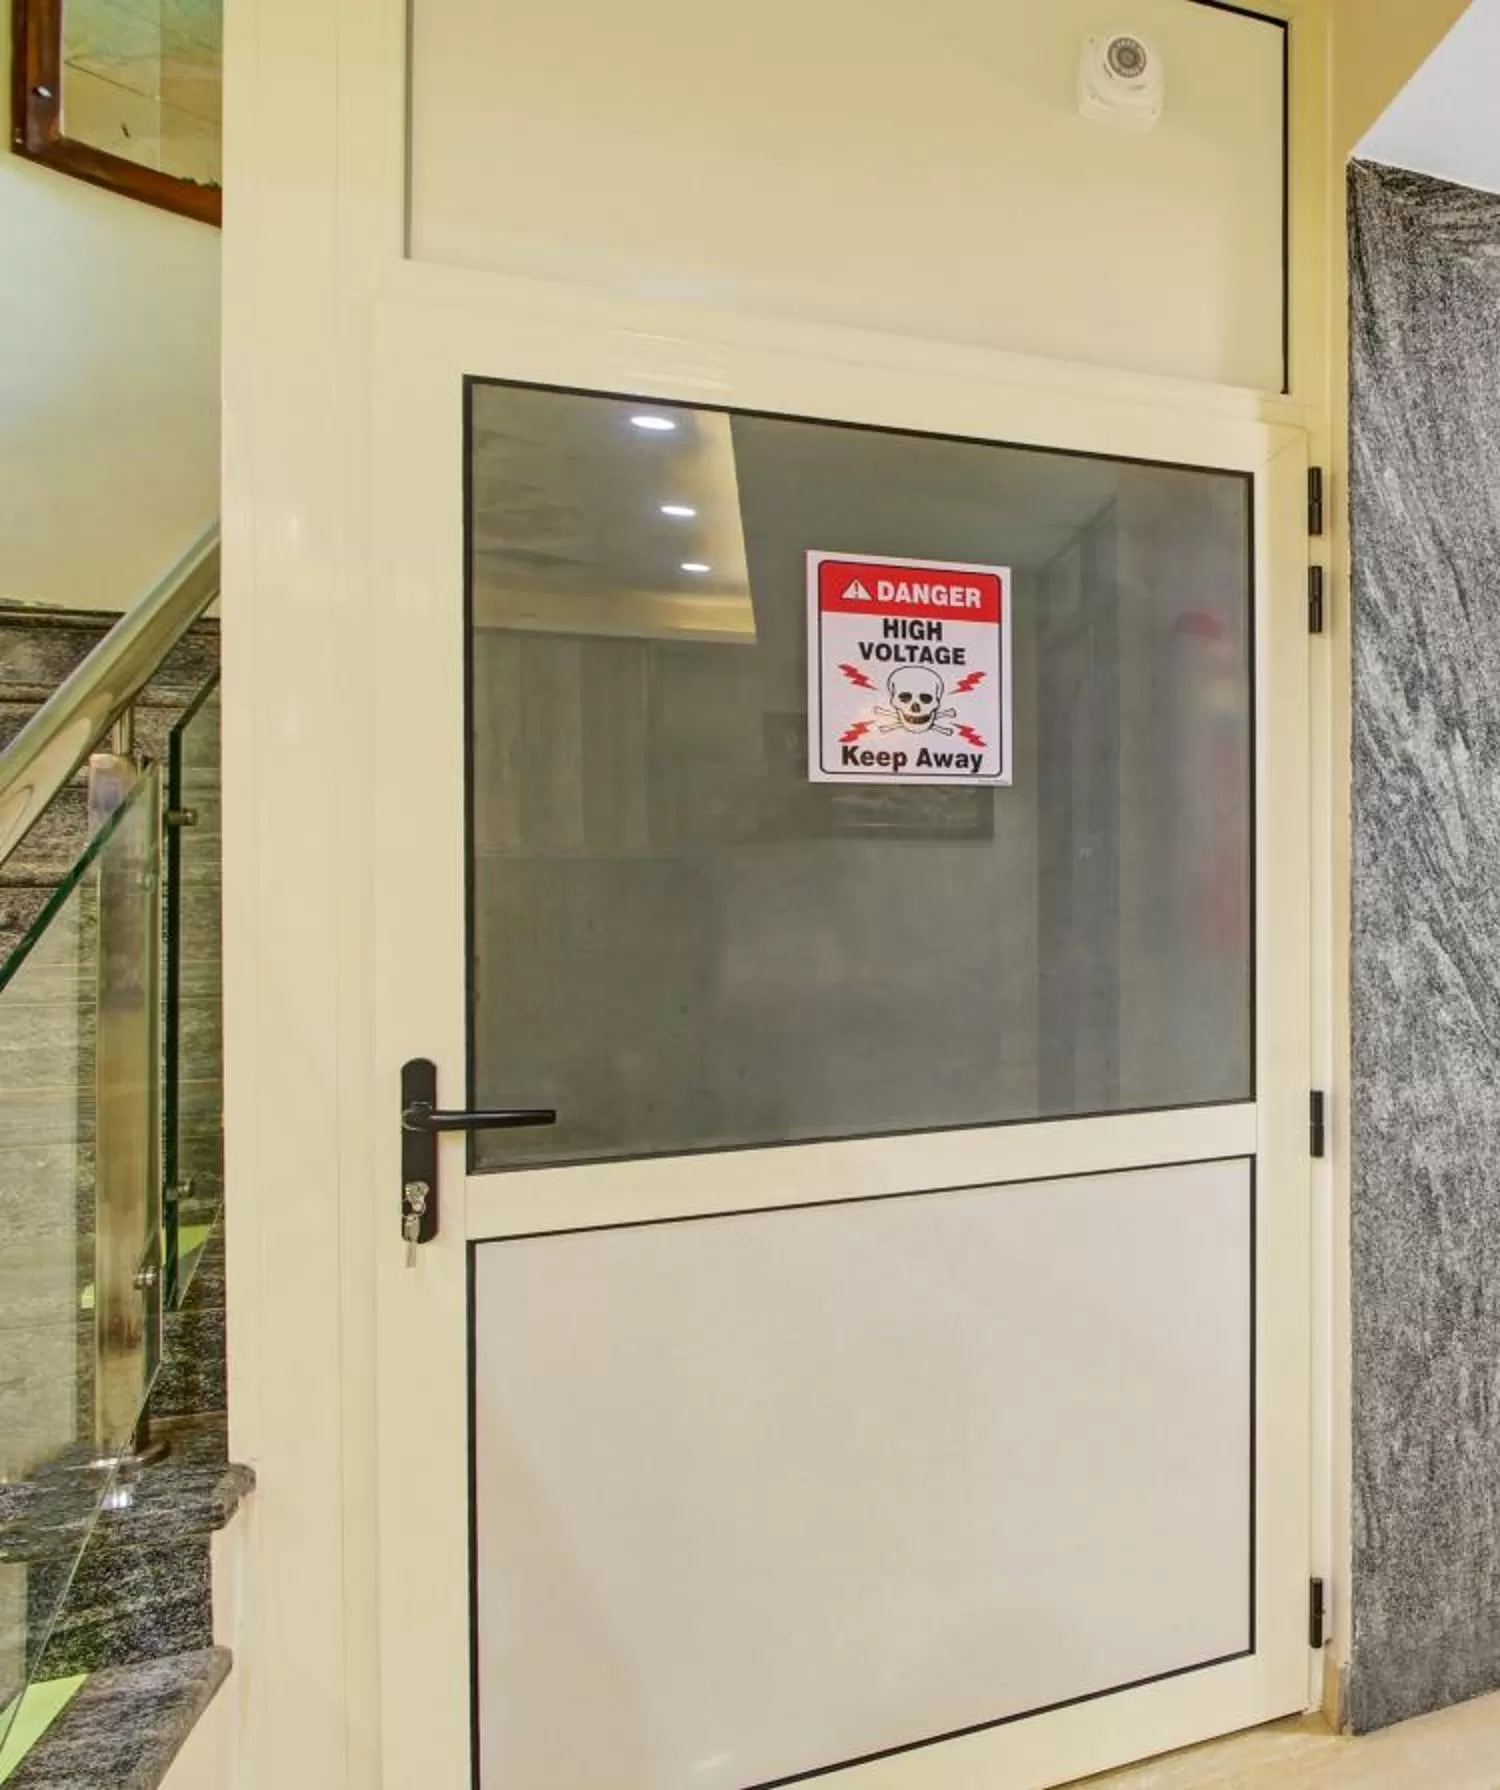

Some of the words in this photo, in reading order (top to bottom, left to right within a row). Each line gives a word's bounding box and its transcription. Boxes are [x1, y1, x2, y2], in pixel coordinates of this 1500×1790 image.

[877, 580, 982, 609] DANGER
[882, 618, 943, 642] HIGH
[858, 641, 966, 666] VOLTAGE
[841, 745, 908, 772] Keep
[915, 748, 984, 773] Away
